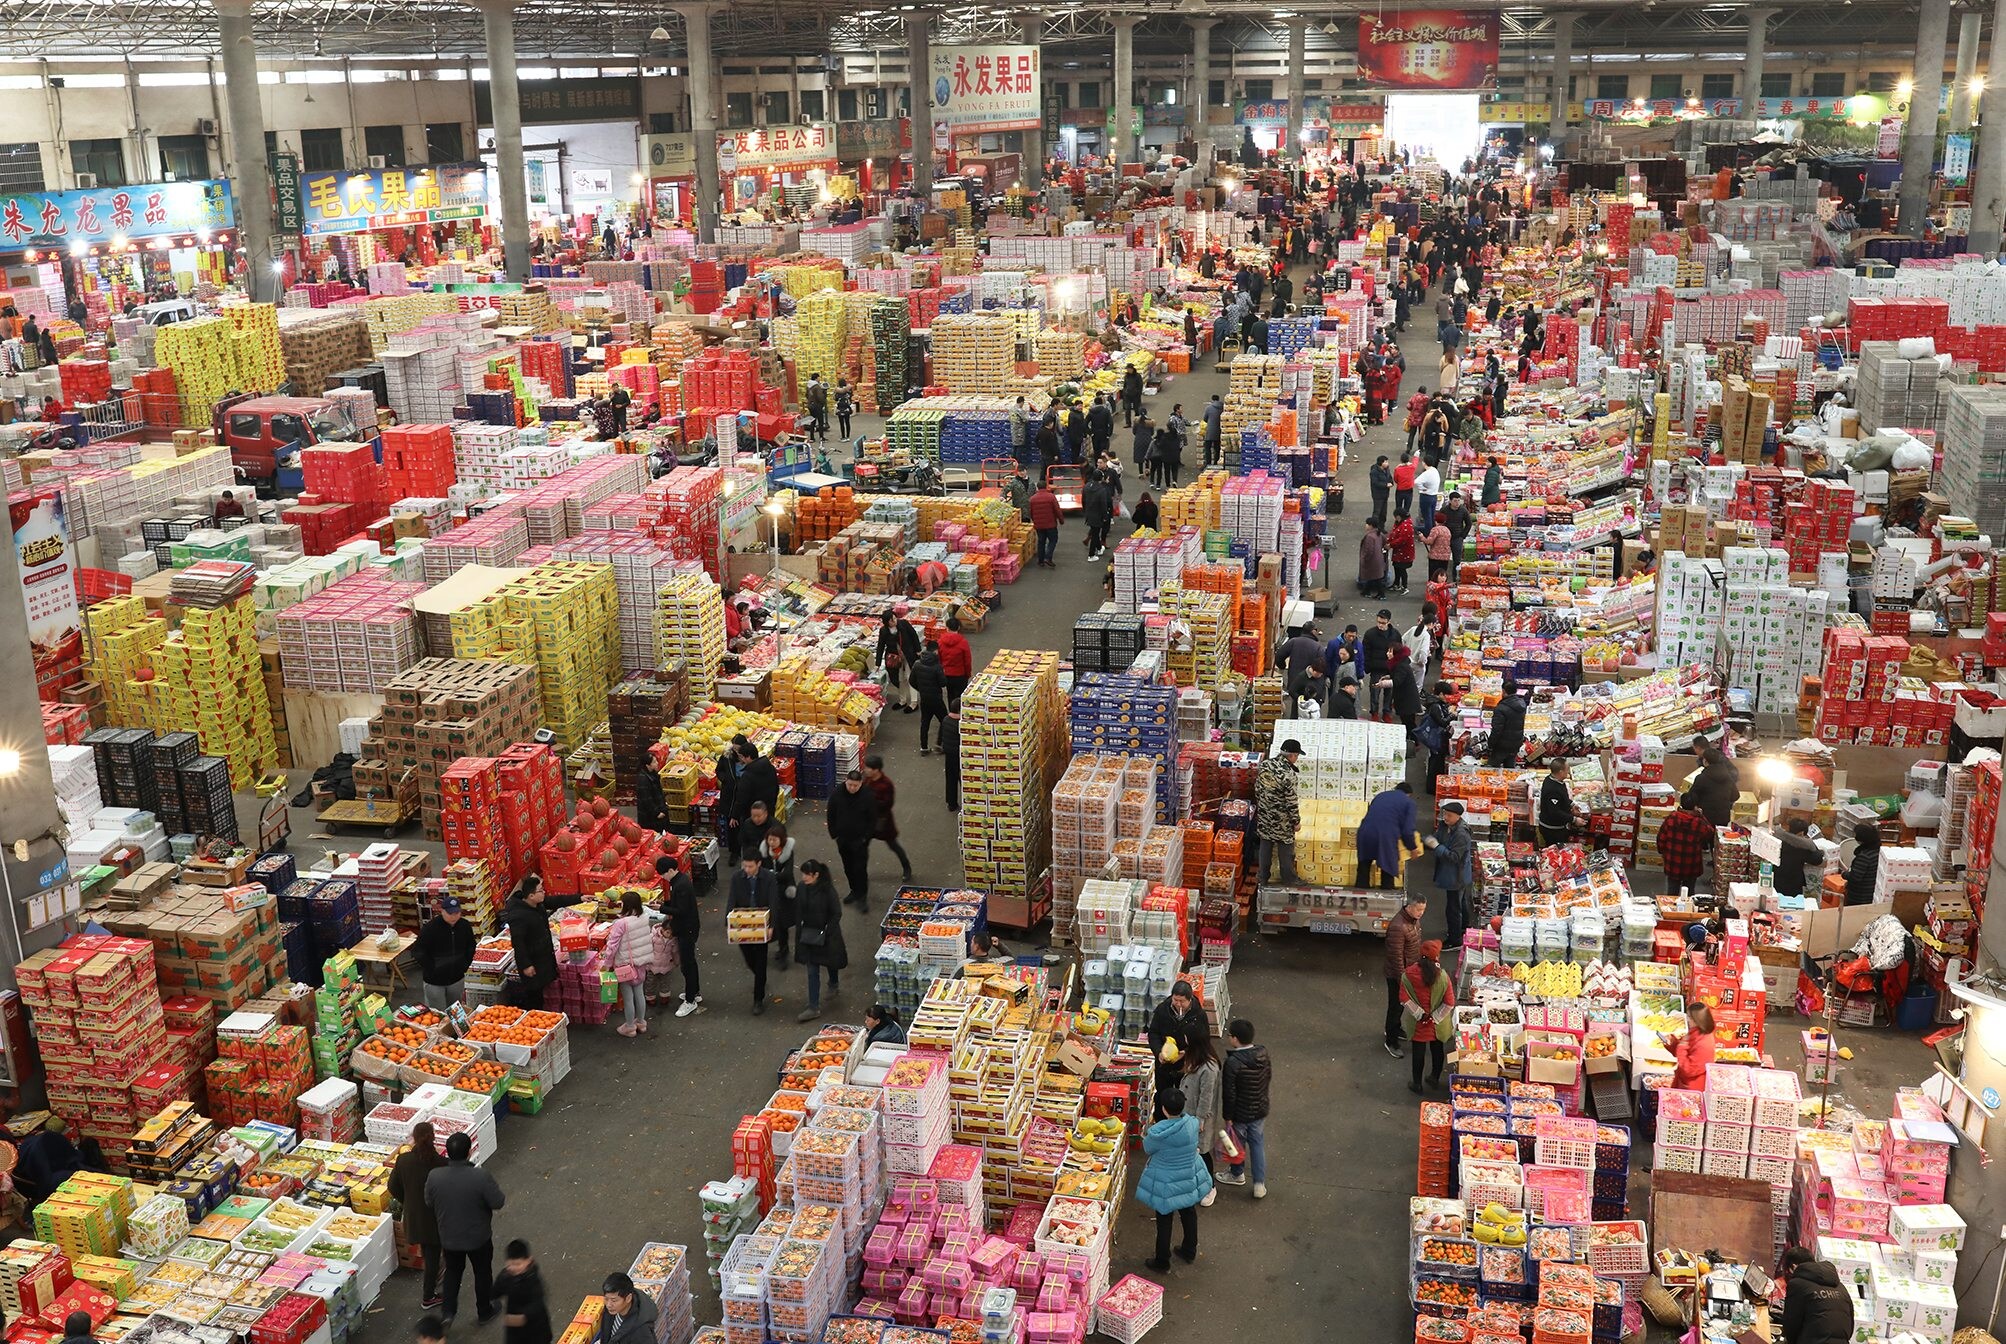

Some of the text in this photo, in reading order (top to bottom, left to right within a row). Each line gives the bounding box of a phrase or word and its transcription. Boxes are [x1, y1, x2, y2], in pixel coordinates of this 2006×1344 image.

[1369, 24, 1488, 44] 社会主义核心价值观
[953, 55, 1032, 97] 永发果品
[957, 102, 984, 112] YONG
[989, 101, 1000, 110] FA
[1005, 100, 1031, 109] FRUIT
[1591, 100, 1739, 117] 周洪富果行
[276, 158, 299, 228] 果品交易区
[309, 169, 441, 218] 毛氏果品
[3, 193, 168, 243] 朱允龙果品
[21, 533, 63, 556] 社会主义
[40, 873, 52, 885] 032
[1983, 1090, 1999, 1106] 027
